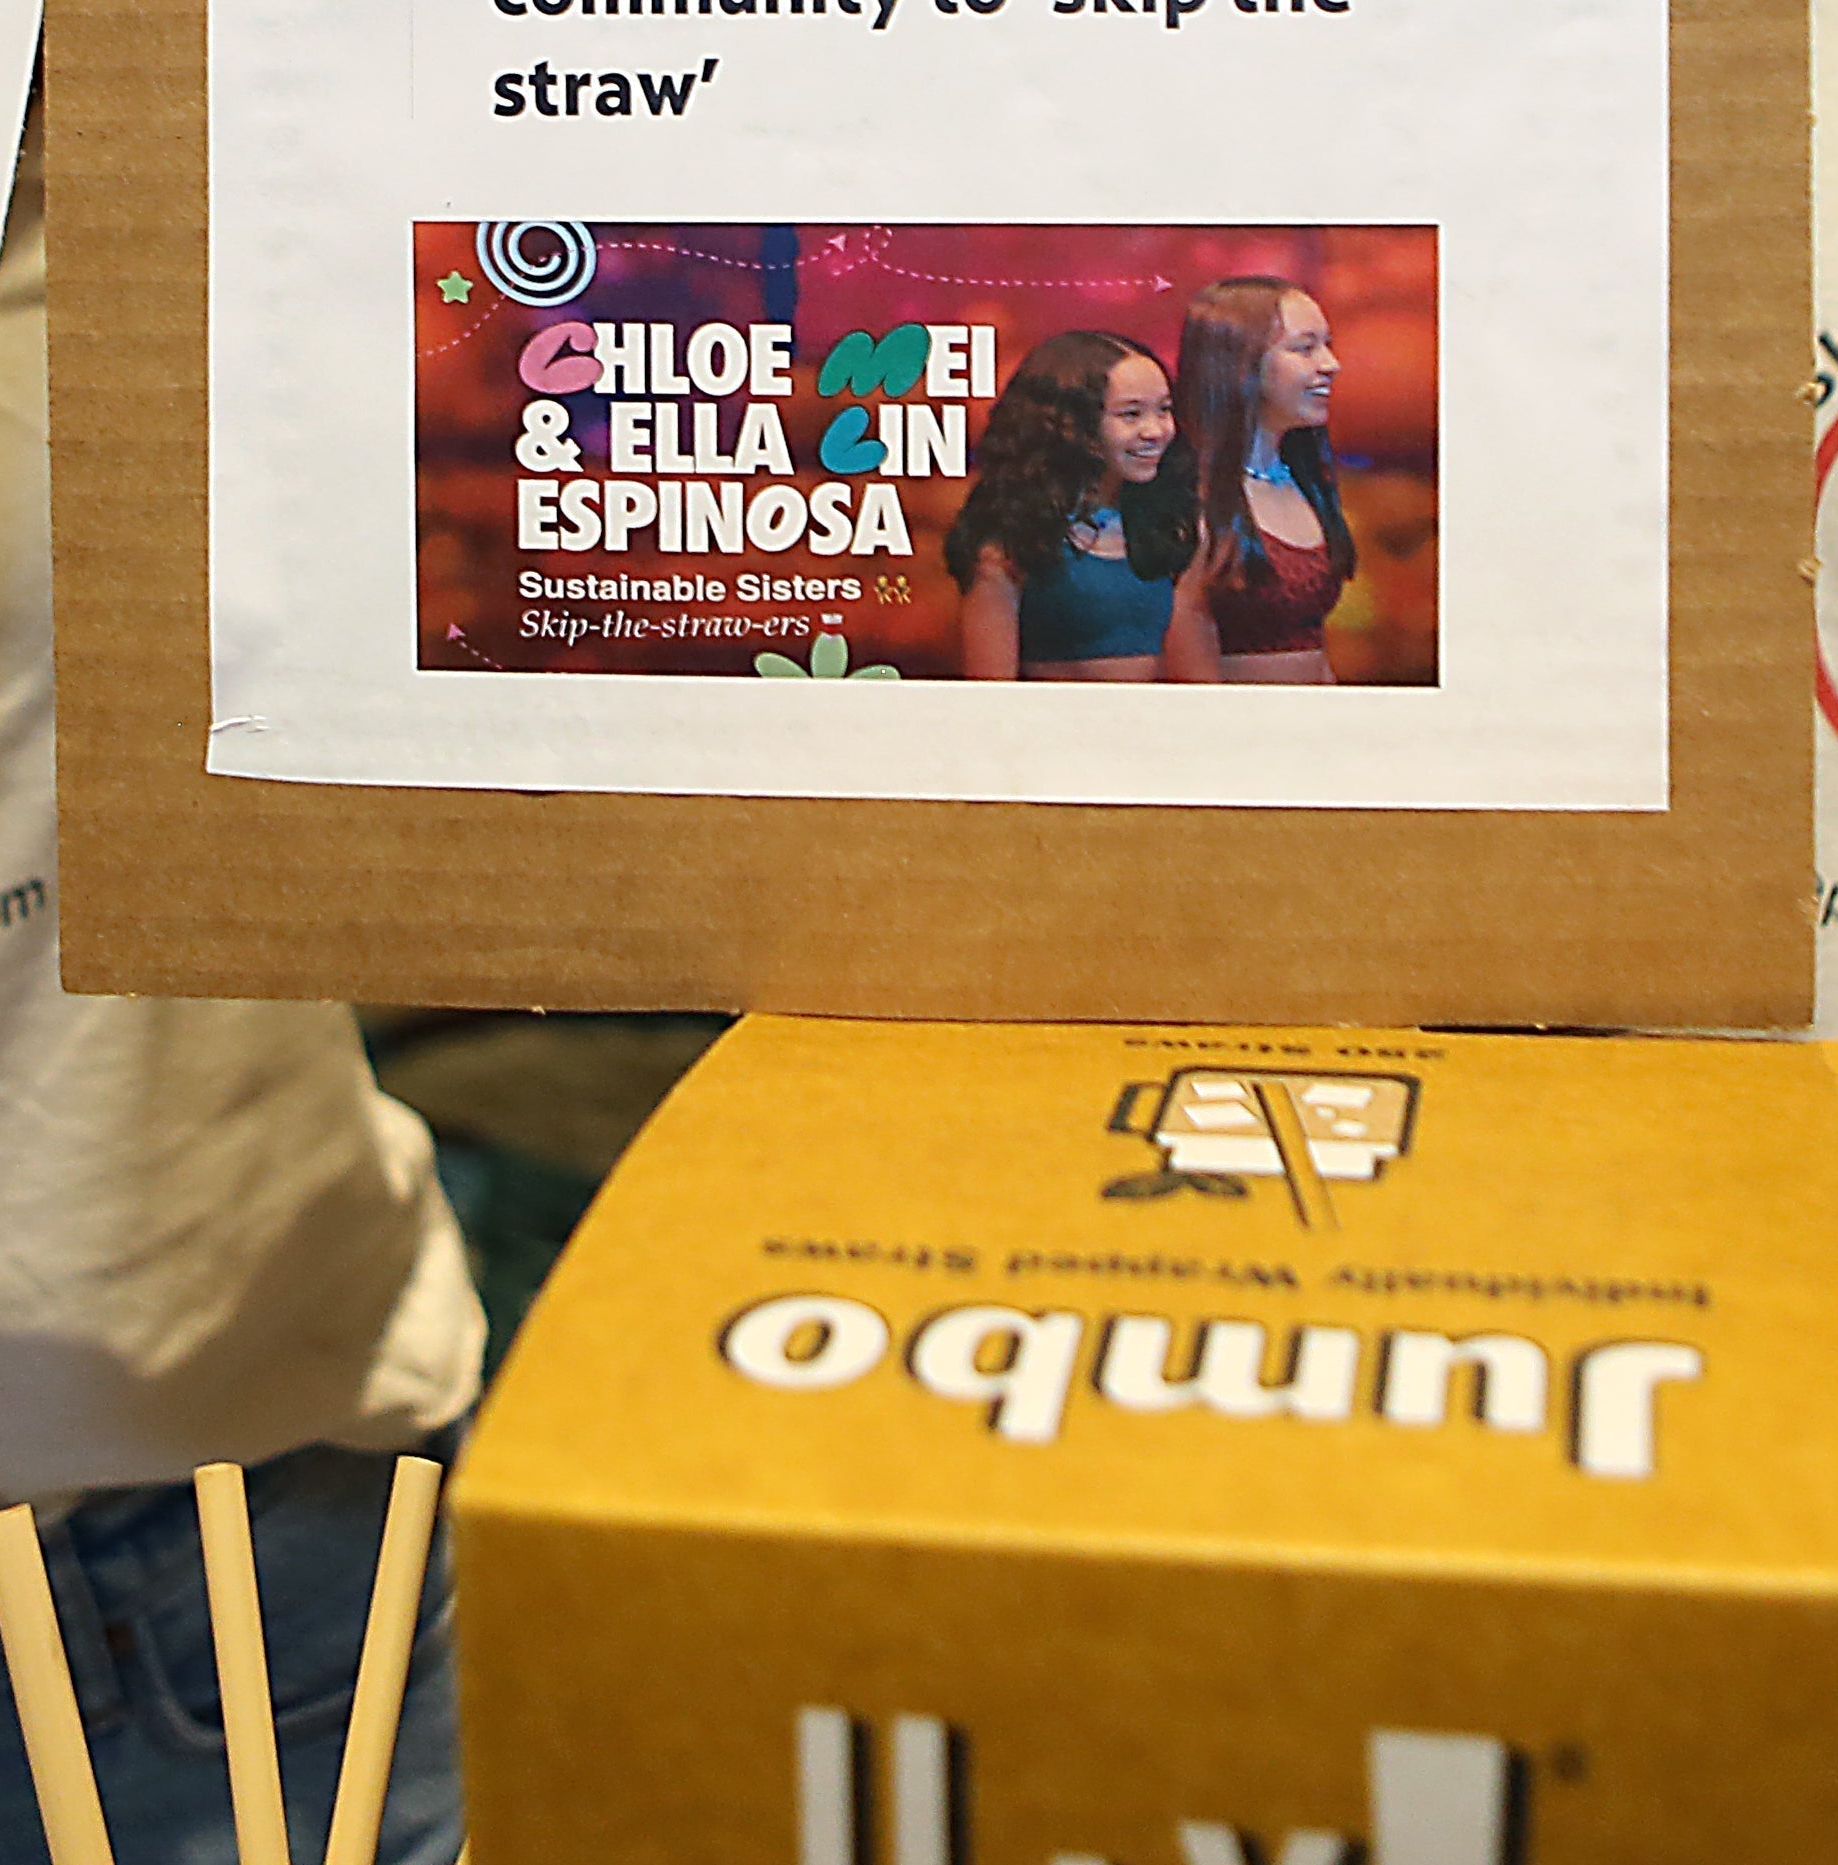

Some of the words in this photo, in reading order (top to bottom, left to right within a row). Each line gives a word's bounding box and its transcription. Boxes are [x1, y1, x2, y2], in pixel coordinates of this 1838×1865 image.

[518, 322, 793, 395] CHLOE
[818, 324, 997, 398] MEI
[516, 400, 583, 474] &
[609, 403, 793, 476] ELLA
[820, 406, 966, 478] LIN
[517, 479, 912, 557] ESPINOSA
[518, 570, 727, 603] Sustainable
[736, 572, 862, 603] Sisters
[518, 609, 811, 643] Skip-the-straw-ers
[1005, 1249, 1303, 1289] Wrapped
[721, 1292, 1706, 1479] Jumbo
